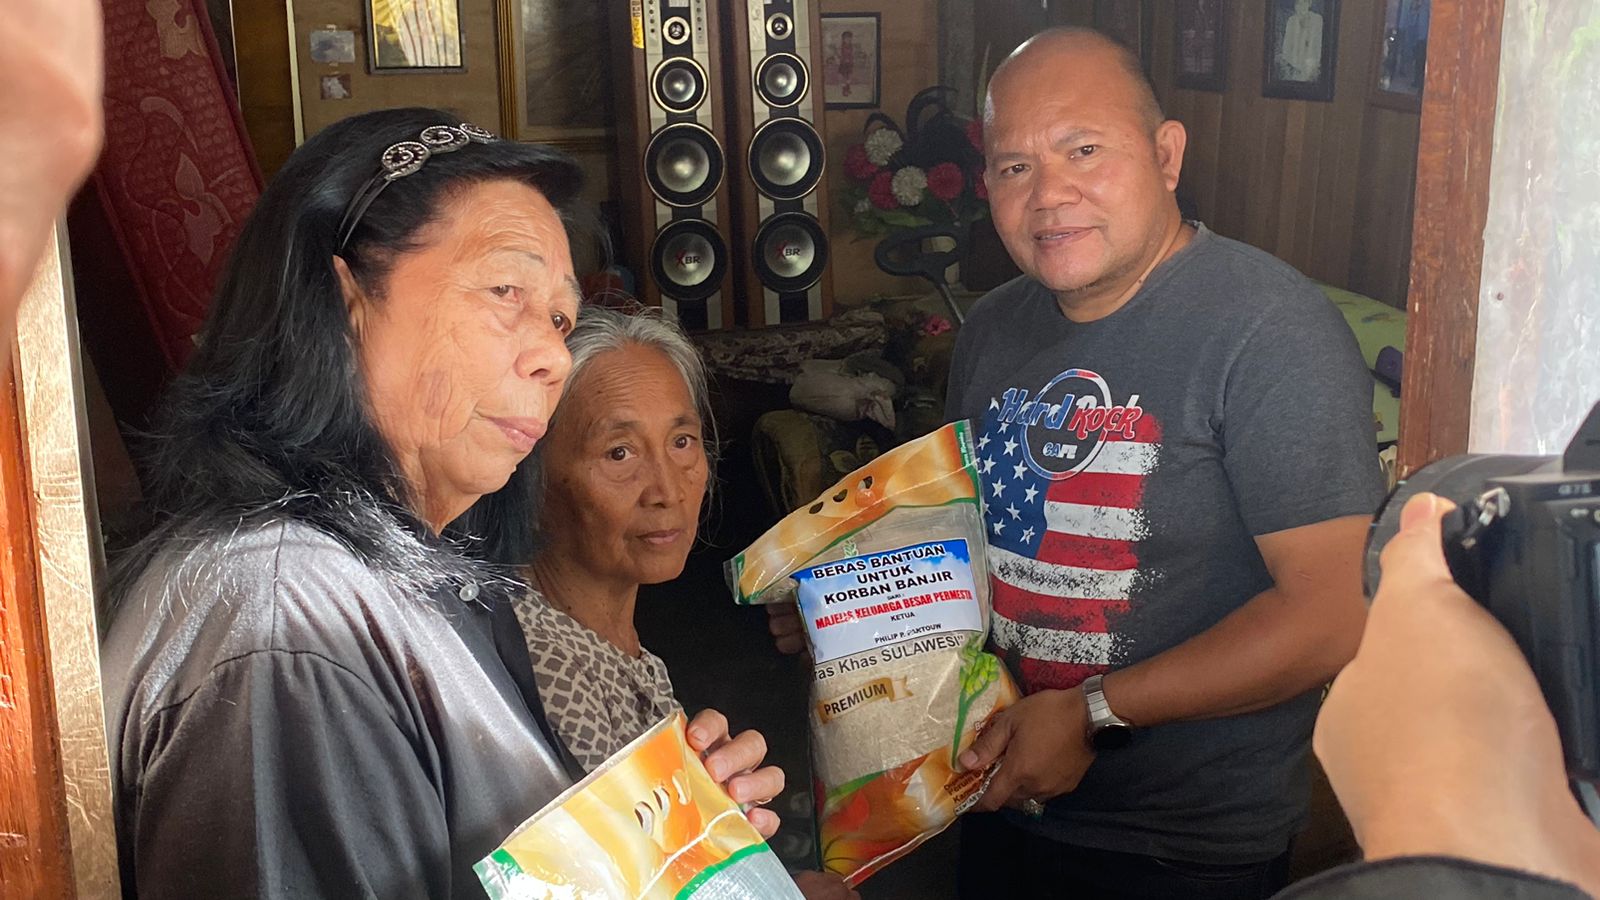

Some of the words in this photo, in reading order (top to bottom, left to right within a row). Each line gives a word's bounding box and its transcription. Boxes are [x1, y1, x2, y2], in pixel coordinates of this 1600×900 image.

[677, 251, 701, 269] XBR
[777, 240, 801, 260] XBR
[998, 387, 1075, 430] Hard
[1068, 394, 1142, 440] Rock
[813, 561, 866, 579] BERAS
[872, 545, 945, 568] BANTUAN
[857, 565, 913, 584] UNTUK
[824, 583, 891, 604] KORBAN
[896, 571, 953, 590] BANJIR
[854, 600, 903, 617] KELUARGA
[903, 595, 933, 609] BESAR
[890, 611, 915, 622] KETUA
[874, 633, 898, 644] PHILIP
[839, 655, 877, 674] Khas
[824, 683, 888, 716] PREMIUM
